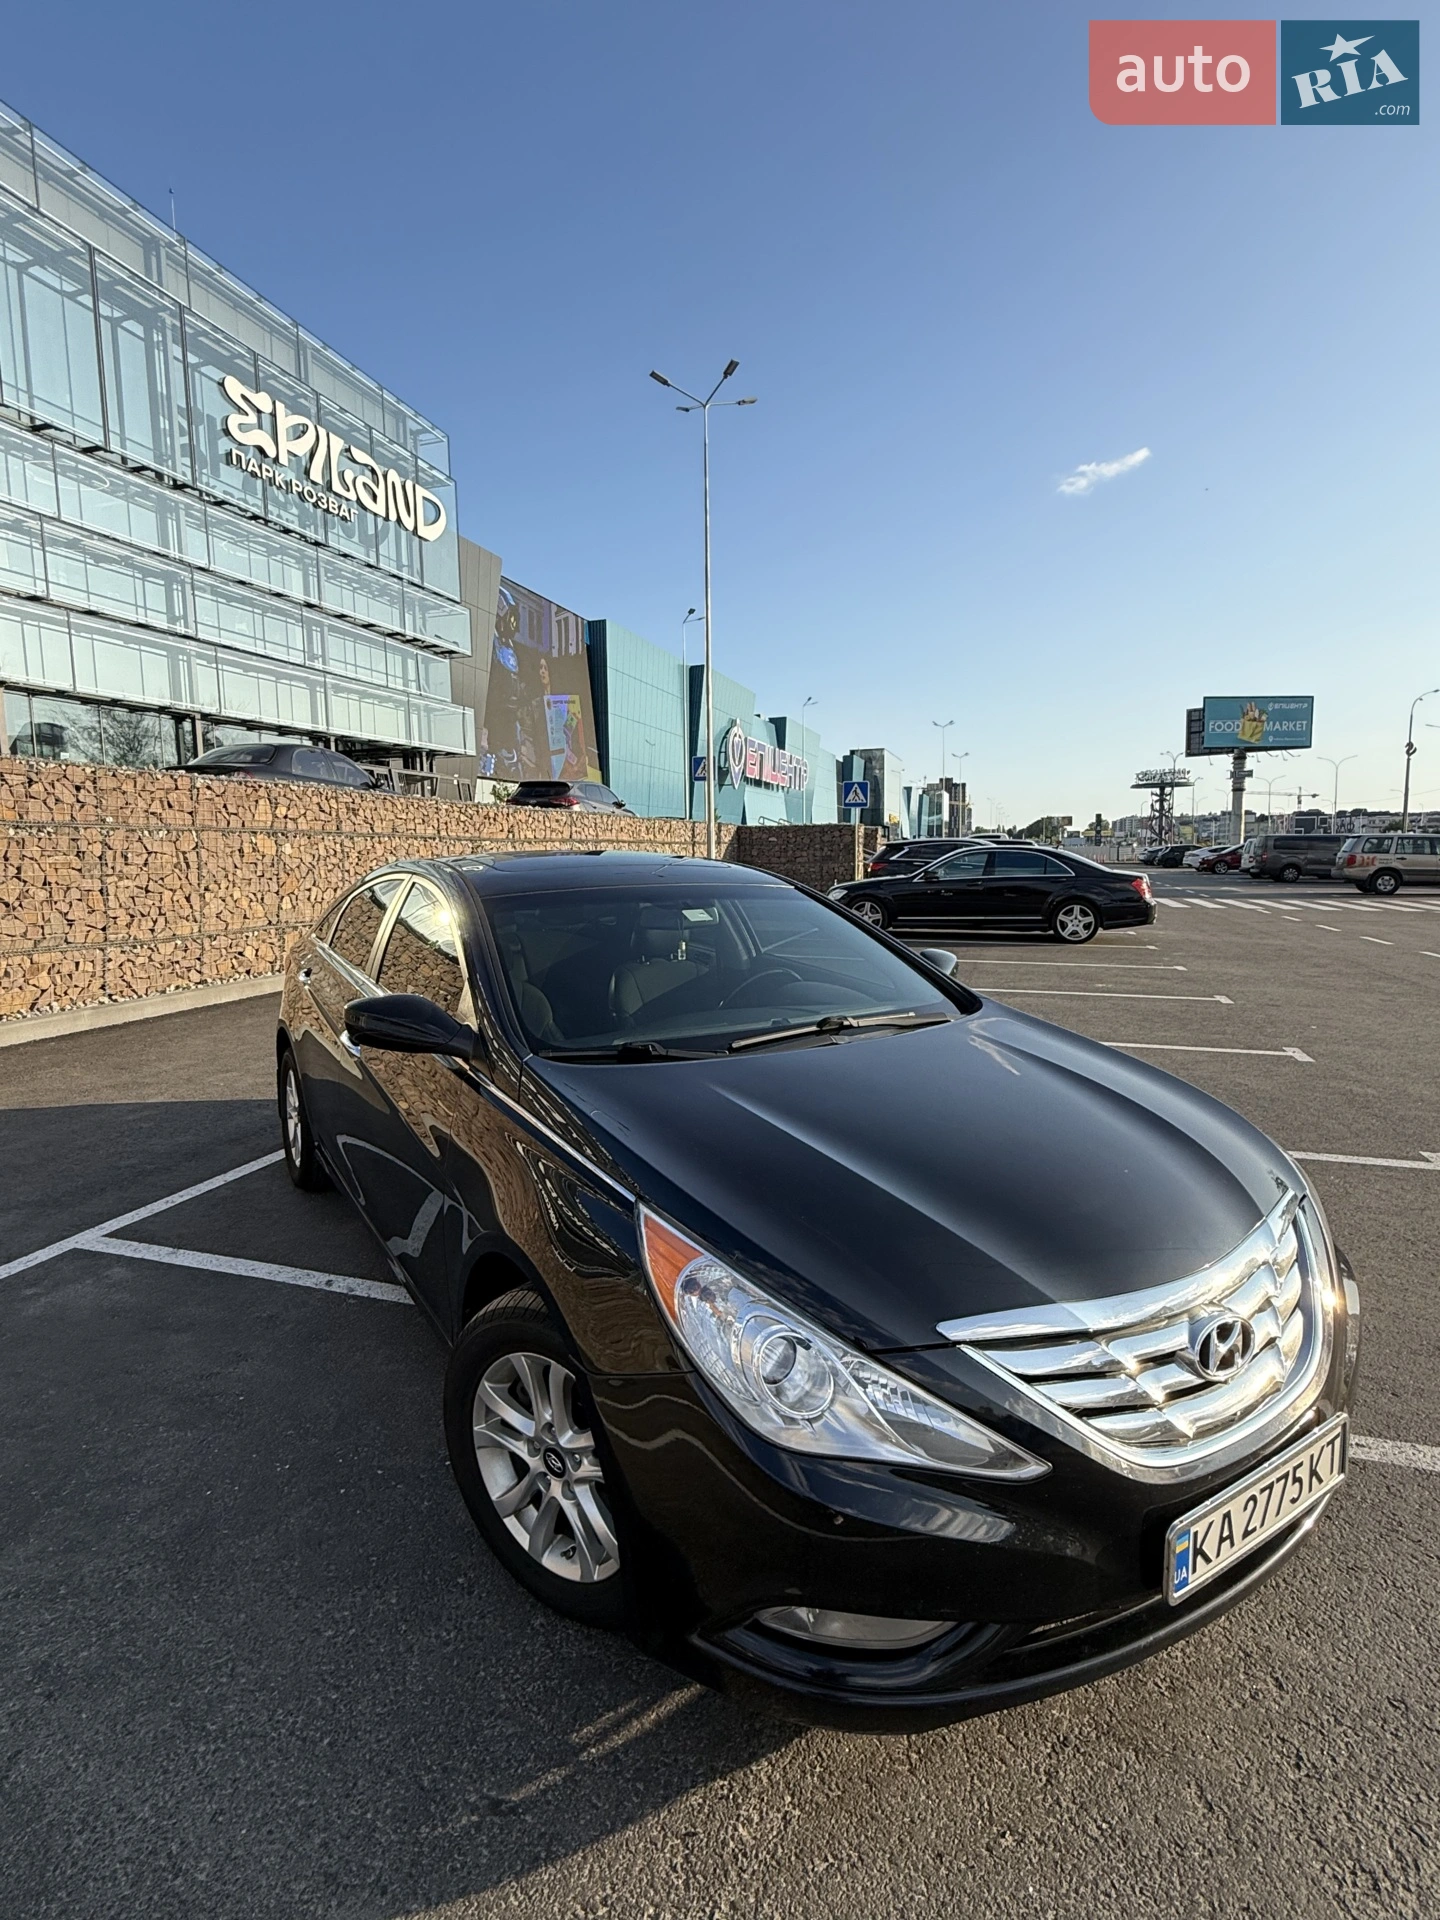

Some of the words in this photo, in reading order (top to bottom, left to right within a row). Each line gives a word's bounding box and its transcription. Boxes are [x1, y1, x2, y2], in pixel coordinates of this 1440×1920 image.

[230, 448, 286, 490] ПАРК
[291, 481, 359, 523] РОЗВАГ
[1208, 721, 1243, 732] FOOD
[1263, 720, 1308, 731] MARKET
[1190, 1509, 1236, 1576] KA
[1241, 1460, 1305, 1541] 2775
[1307, 1431, 1342, 1495] KT
[1174, 1570, 1188, 1584] UA
